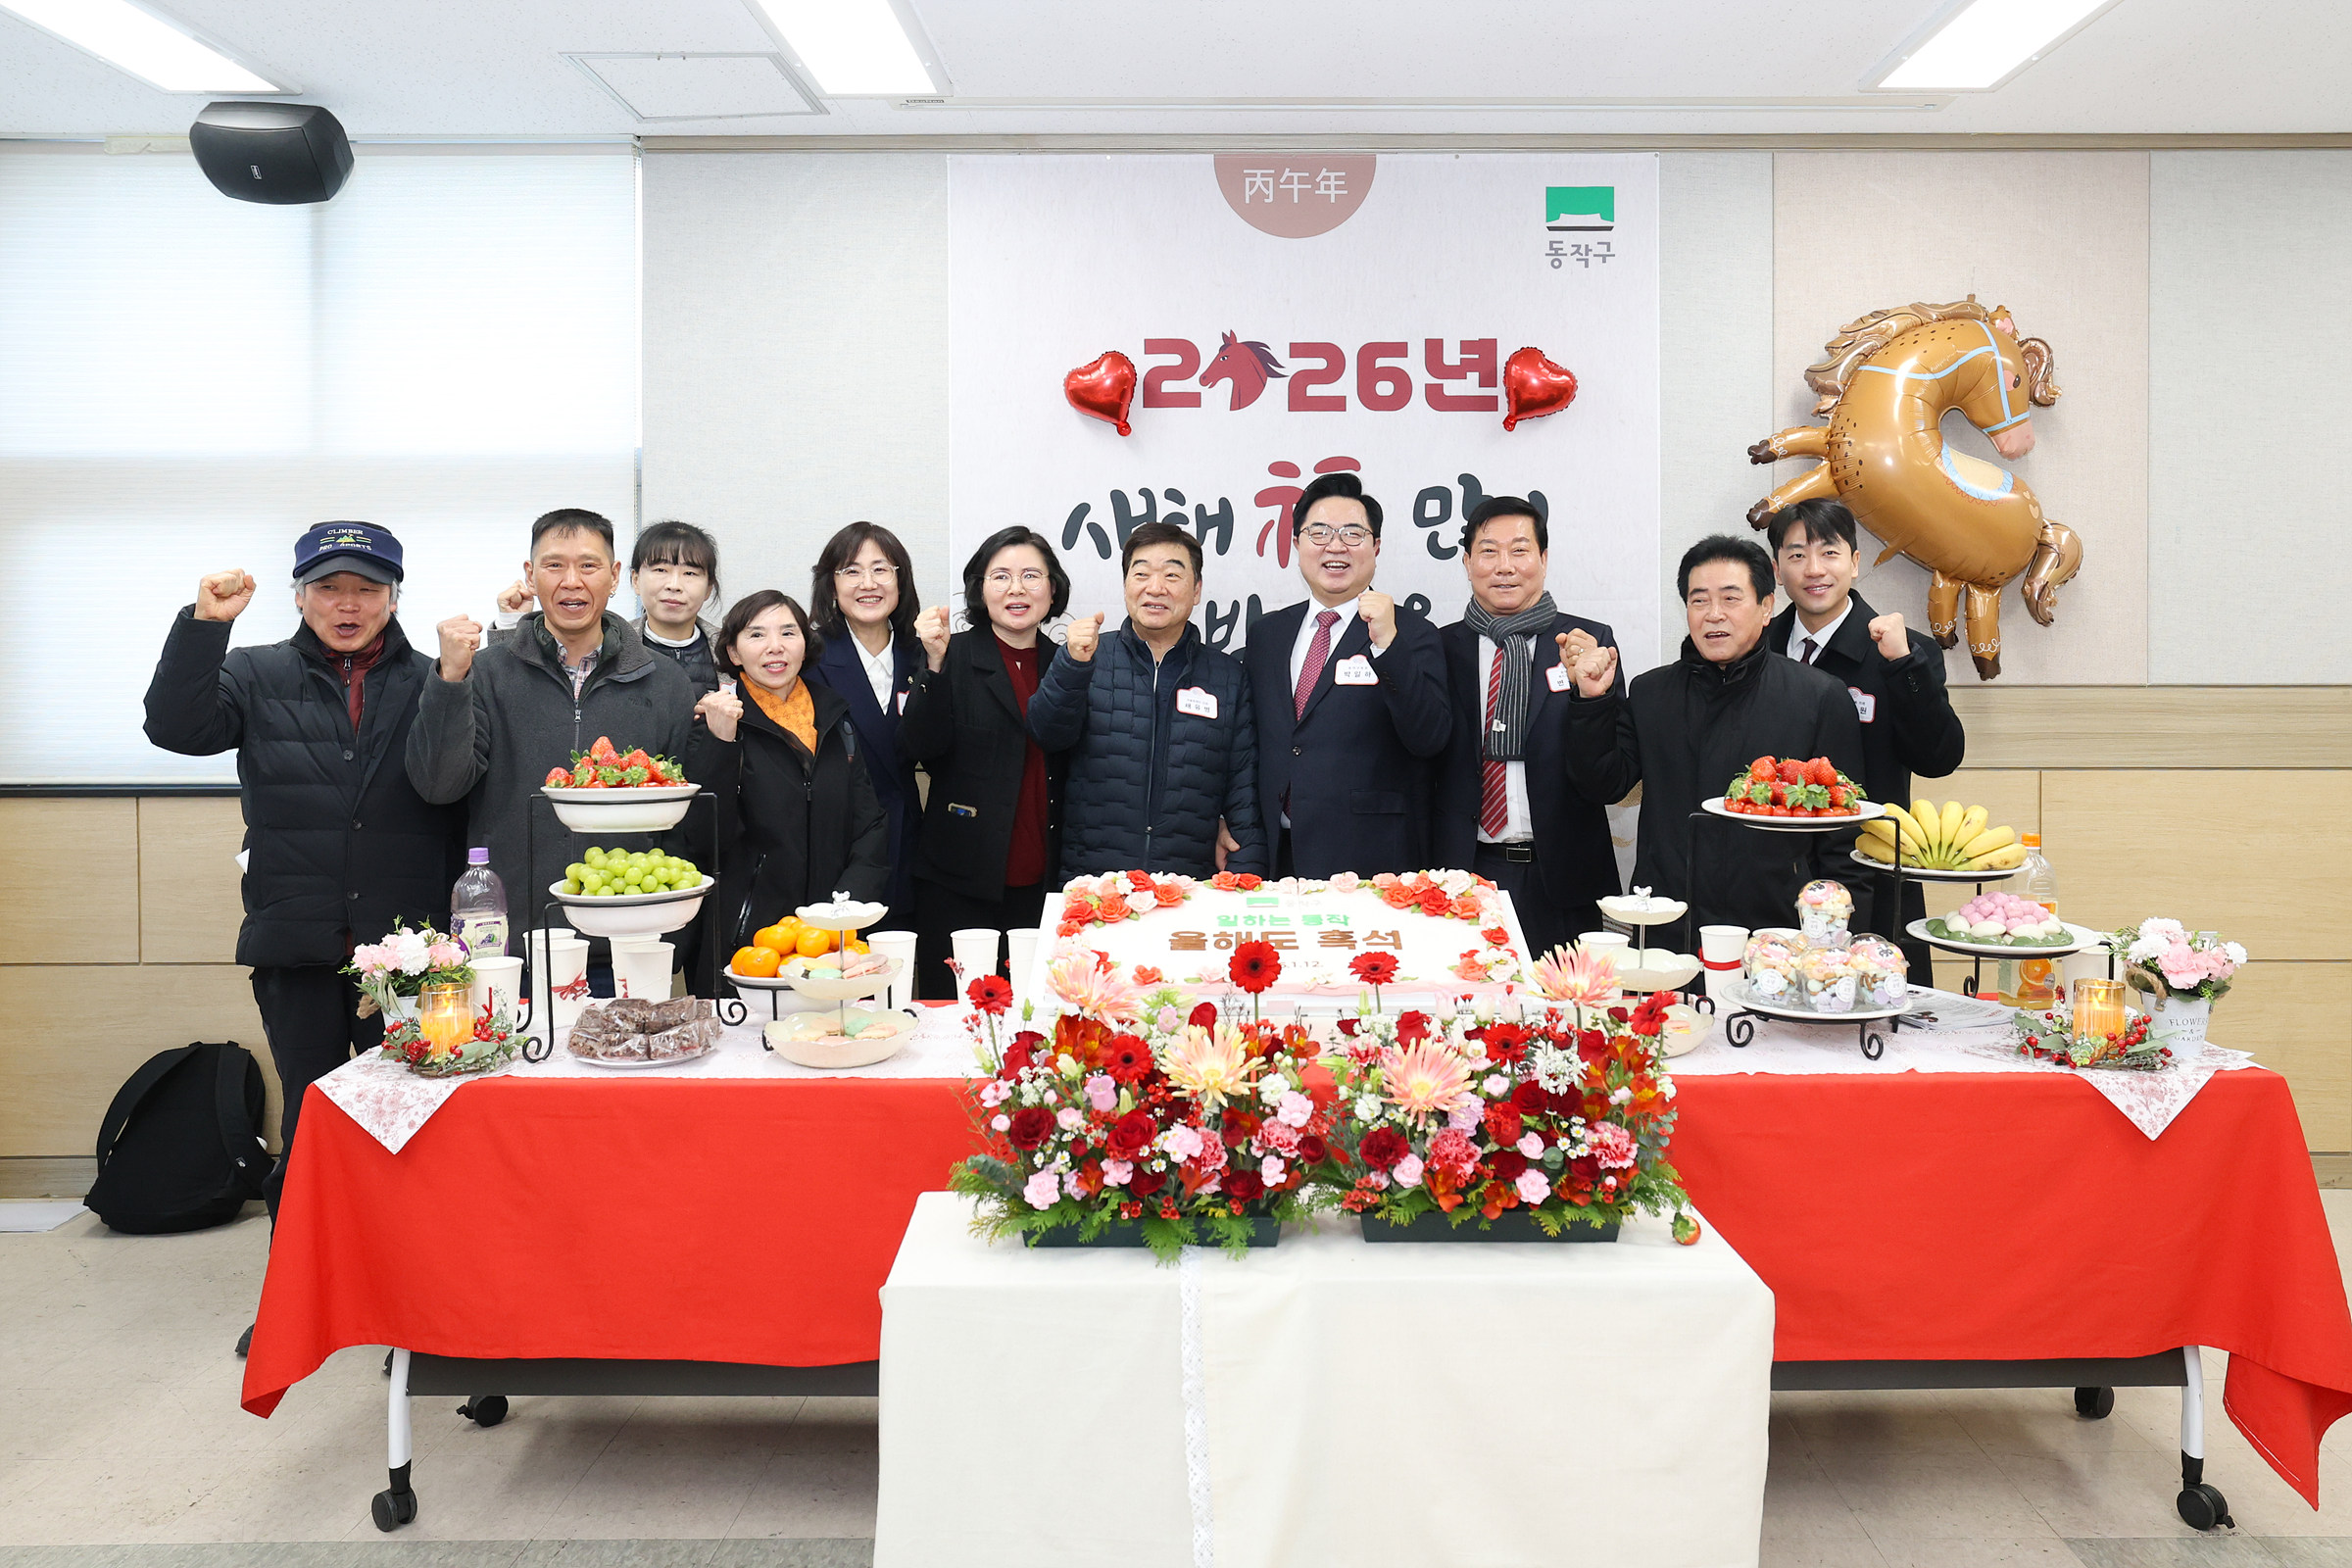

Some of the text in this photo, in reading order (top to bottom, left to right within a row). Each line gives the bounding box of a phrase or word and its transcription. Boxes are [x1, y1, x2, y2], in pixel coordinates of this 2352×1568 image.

[1243, 167, 1348, 204] 丙午年
[1544, 239, 1616, 270] 동작구
[1412, 472, 1549, 562] 많
[1216, 913, 1292, 927] 일하는
[1168, 929, 1403, 952] 올해도 흑석
